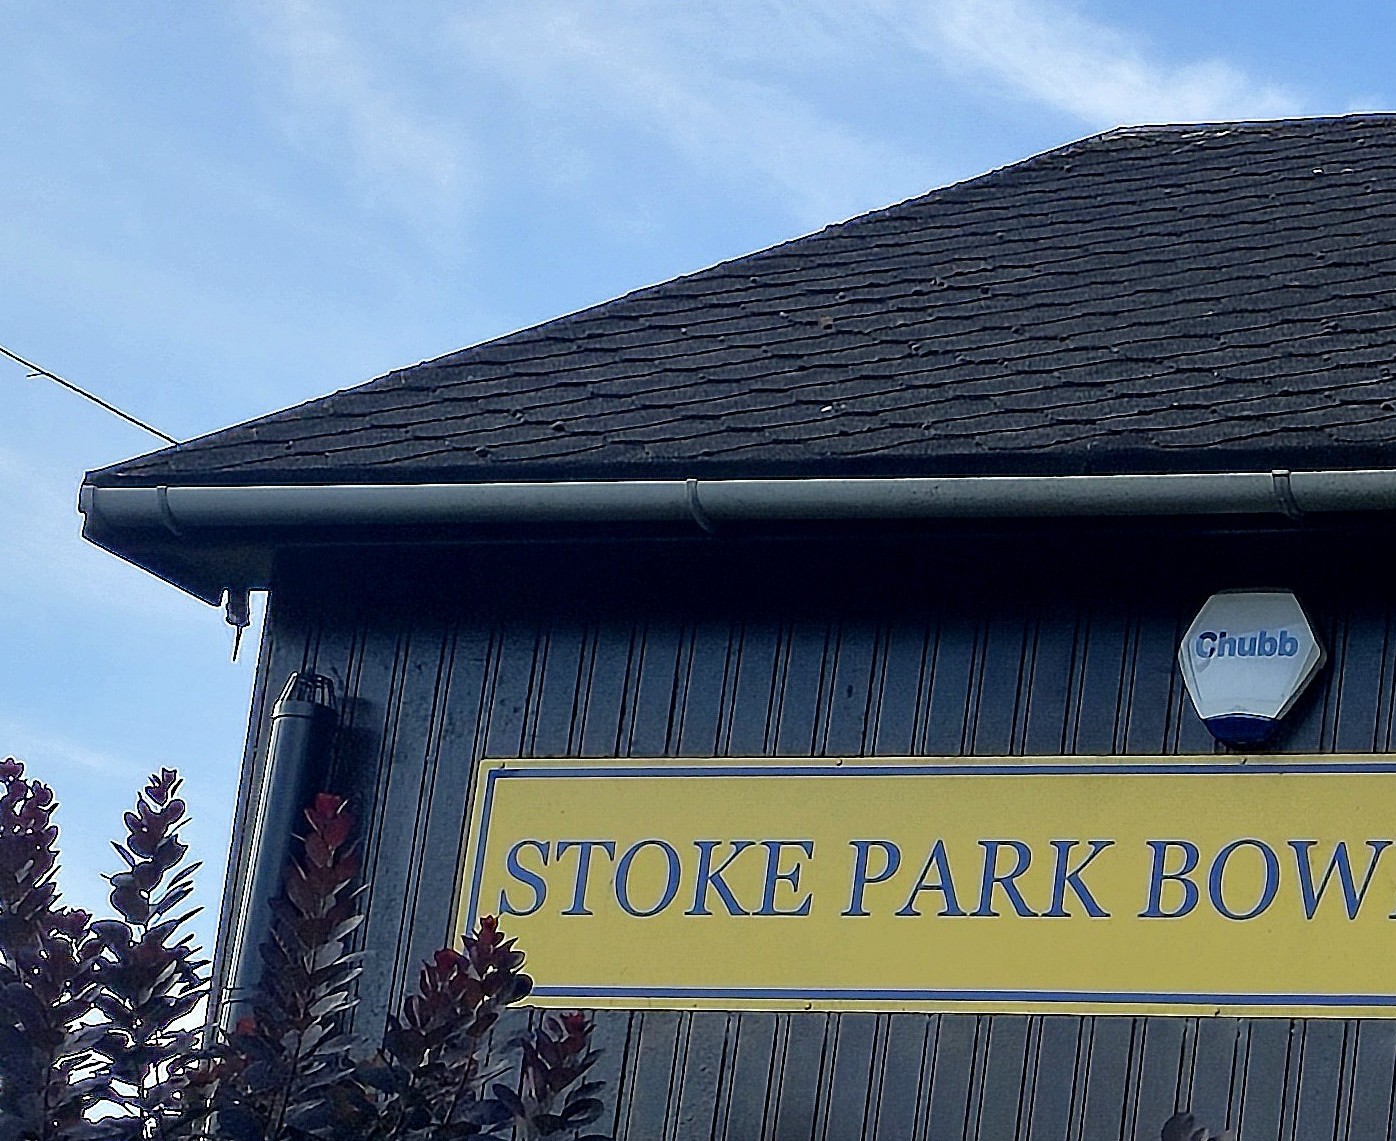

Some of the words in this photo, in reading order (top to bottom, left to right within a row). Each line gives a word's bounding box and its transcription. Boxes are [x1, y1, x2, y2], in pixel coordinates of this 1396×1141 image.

[1195, 629, 1299, 658] Chubb
[499, 839, 815, 918] STOKE
[840, 838, 1115, 918] PARK
